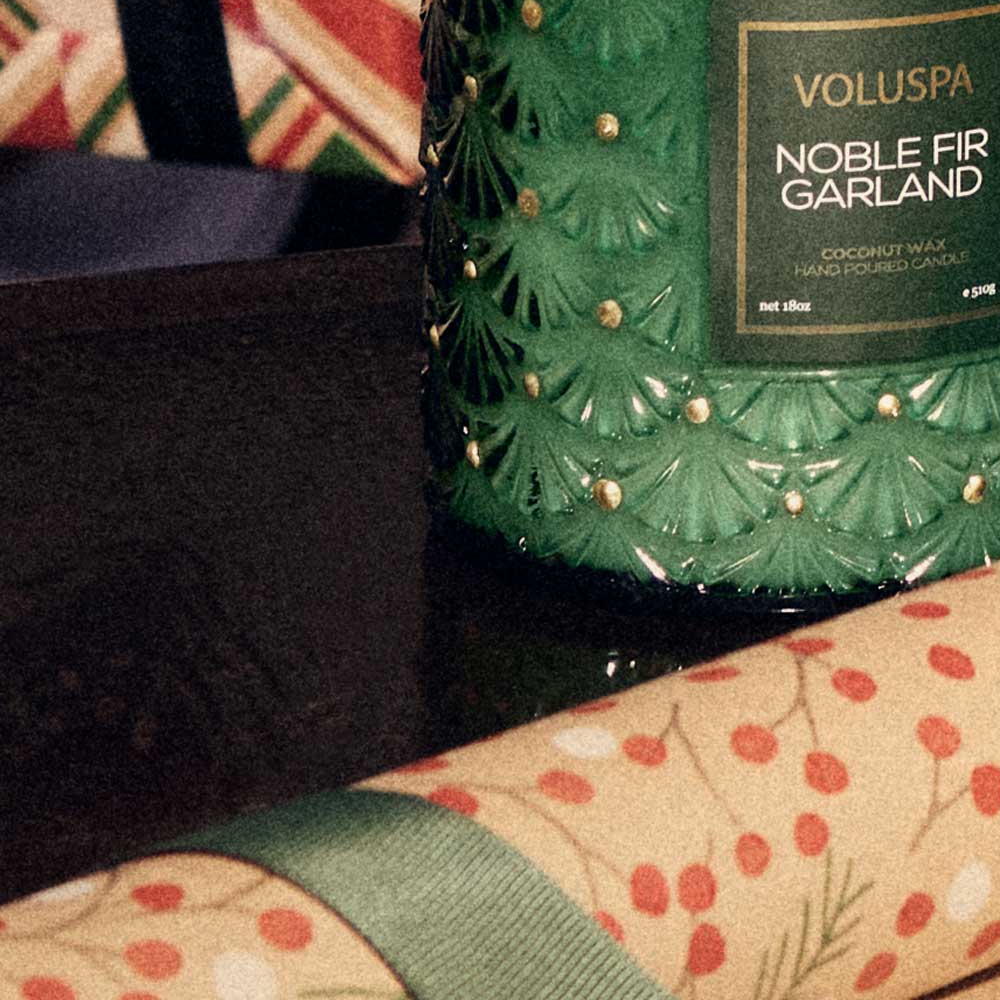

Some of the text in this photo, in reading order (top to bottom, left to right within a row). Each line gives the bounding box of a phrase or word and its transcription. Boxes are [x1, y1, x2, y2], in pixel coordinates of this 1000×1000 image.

[793, 62, 974, 108] VOLUSPA
[776, 128, 989, 174] NOBLE FIR
[781, 165, 983, 210] GARLAND
[794, 251, 970, 277] HAND POURED CANDLE
[821, 238, 947, 261] COCONUT WAX
[759, 300, 812, 313] net 18oz
